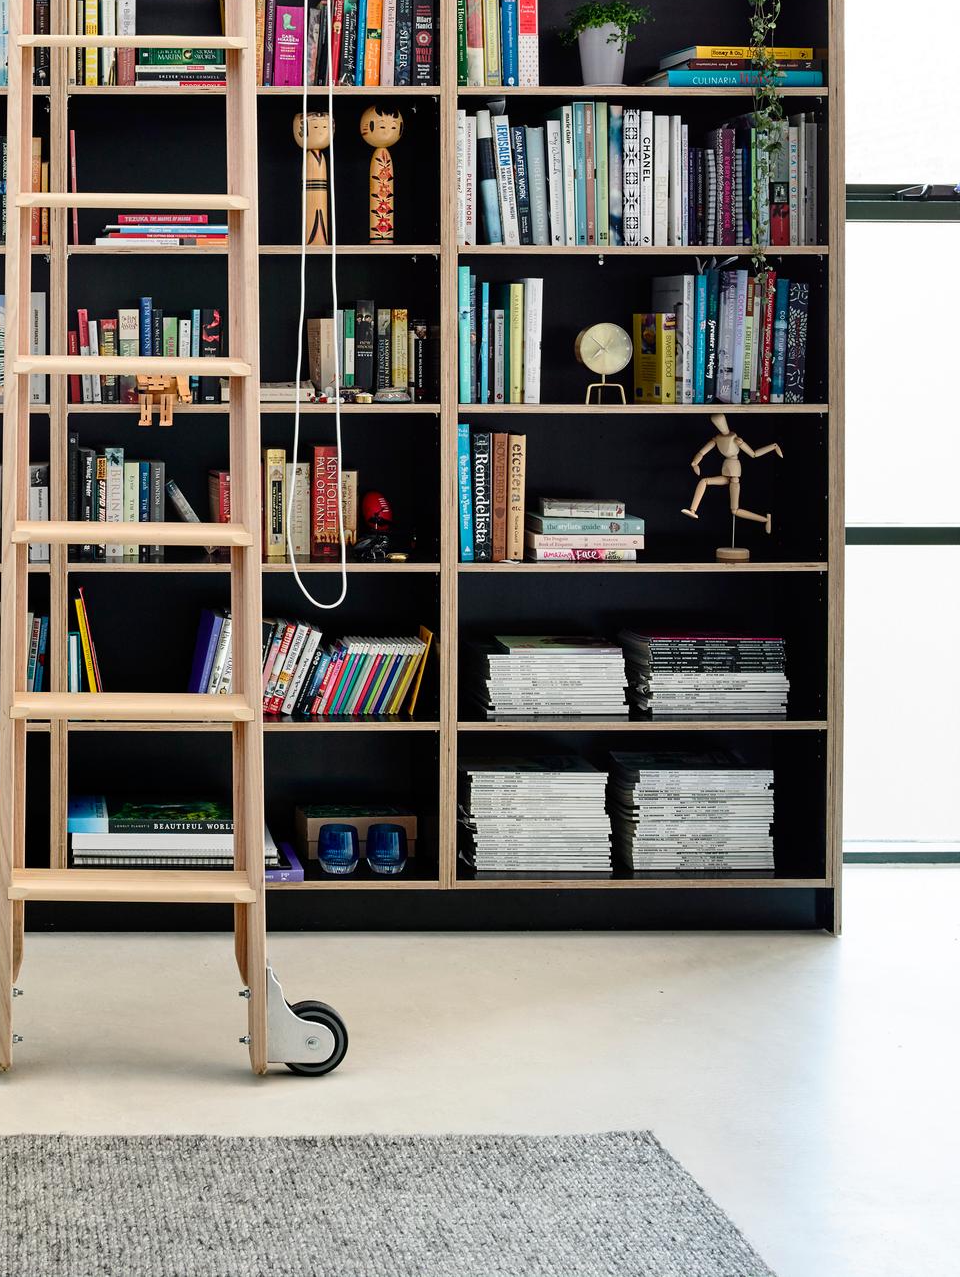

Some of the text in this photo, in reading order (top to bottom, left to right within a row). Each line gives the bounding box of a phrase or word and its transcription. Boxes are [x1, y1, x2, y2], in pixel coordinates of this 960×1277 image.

[387, 6, 395, 23] Rudd
[416, 16, 432, 24] Hilary
[399, 30, 408, 68] SILVER
[496, 124, 509, 166] JERUSALEM
[515, 131, 523, 152] ASIAN
[642, 137, 651, 182] CHANEL
[534, 157, 544, 232] NIGELLA LAWSON
[656, 176, 666, 226] PLENTY
[737, 294, 745, 327] COCKTAIL
[666, 361, 674, 377] food
[706, 320, 717, 379] Greater Mekong
[98, 480, 106, 506] STUPID
[110, 469, 121, 511] BERLIN
[495, 441, 505, 504] BOWERBIRD
[511, 444, 522, 502] etcetera
[316, 457, 325, 533] FALL OF GIANTS
[326, 457, 338, 532] KEN FOLLETT
[475, 453, 490, 543] Remodelista
[219, 630, 230, 650] PARIS
[292, 633, 305, 652] FRENCH
